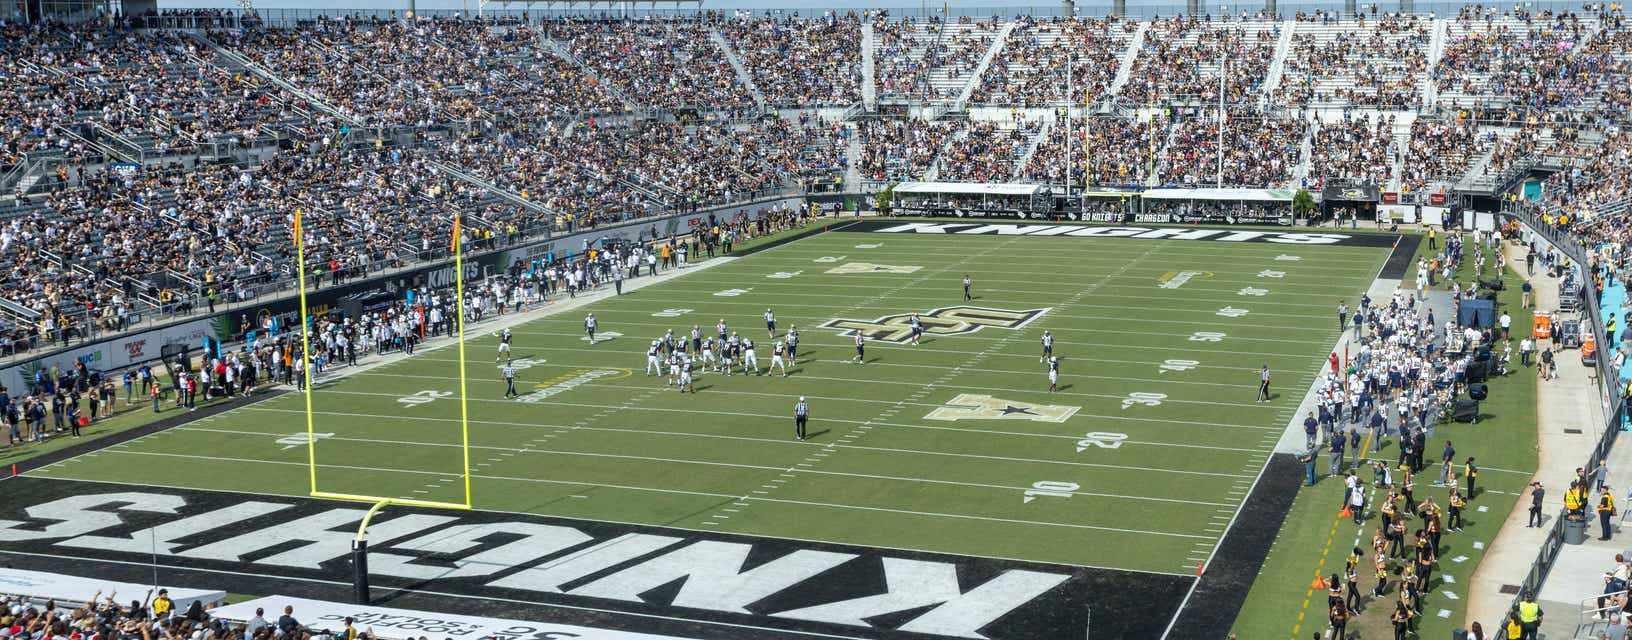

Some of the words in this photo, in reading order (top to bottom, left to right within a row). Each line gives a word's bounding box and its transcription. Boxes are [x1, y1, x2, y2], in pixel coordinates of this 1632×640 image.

[873, 223, 1352, 244] KNIGHTS
[1078, 431, 1128, 449] 20
[1024, 480, 1080, 498] 10
[0, 491, 1073, 640] KNIGHTS
